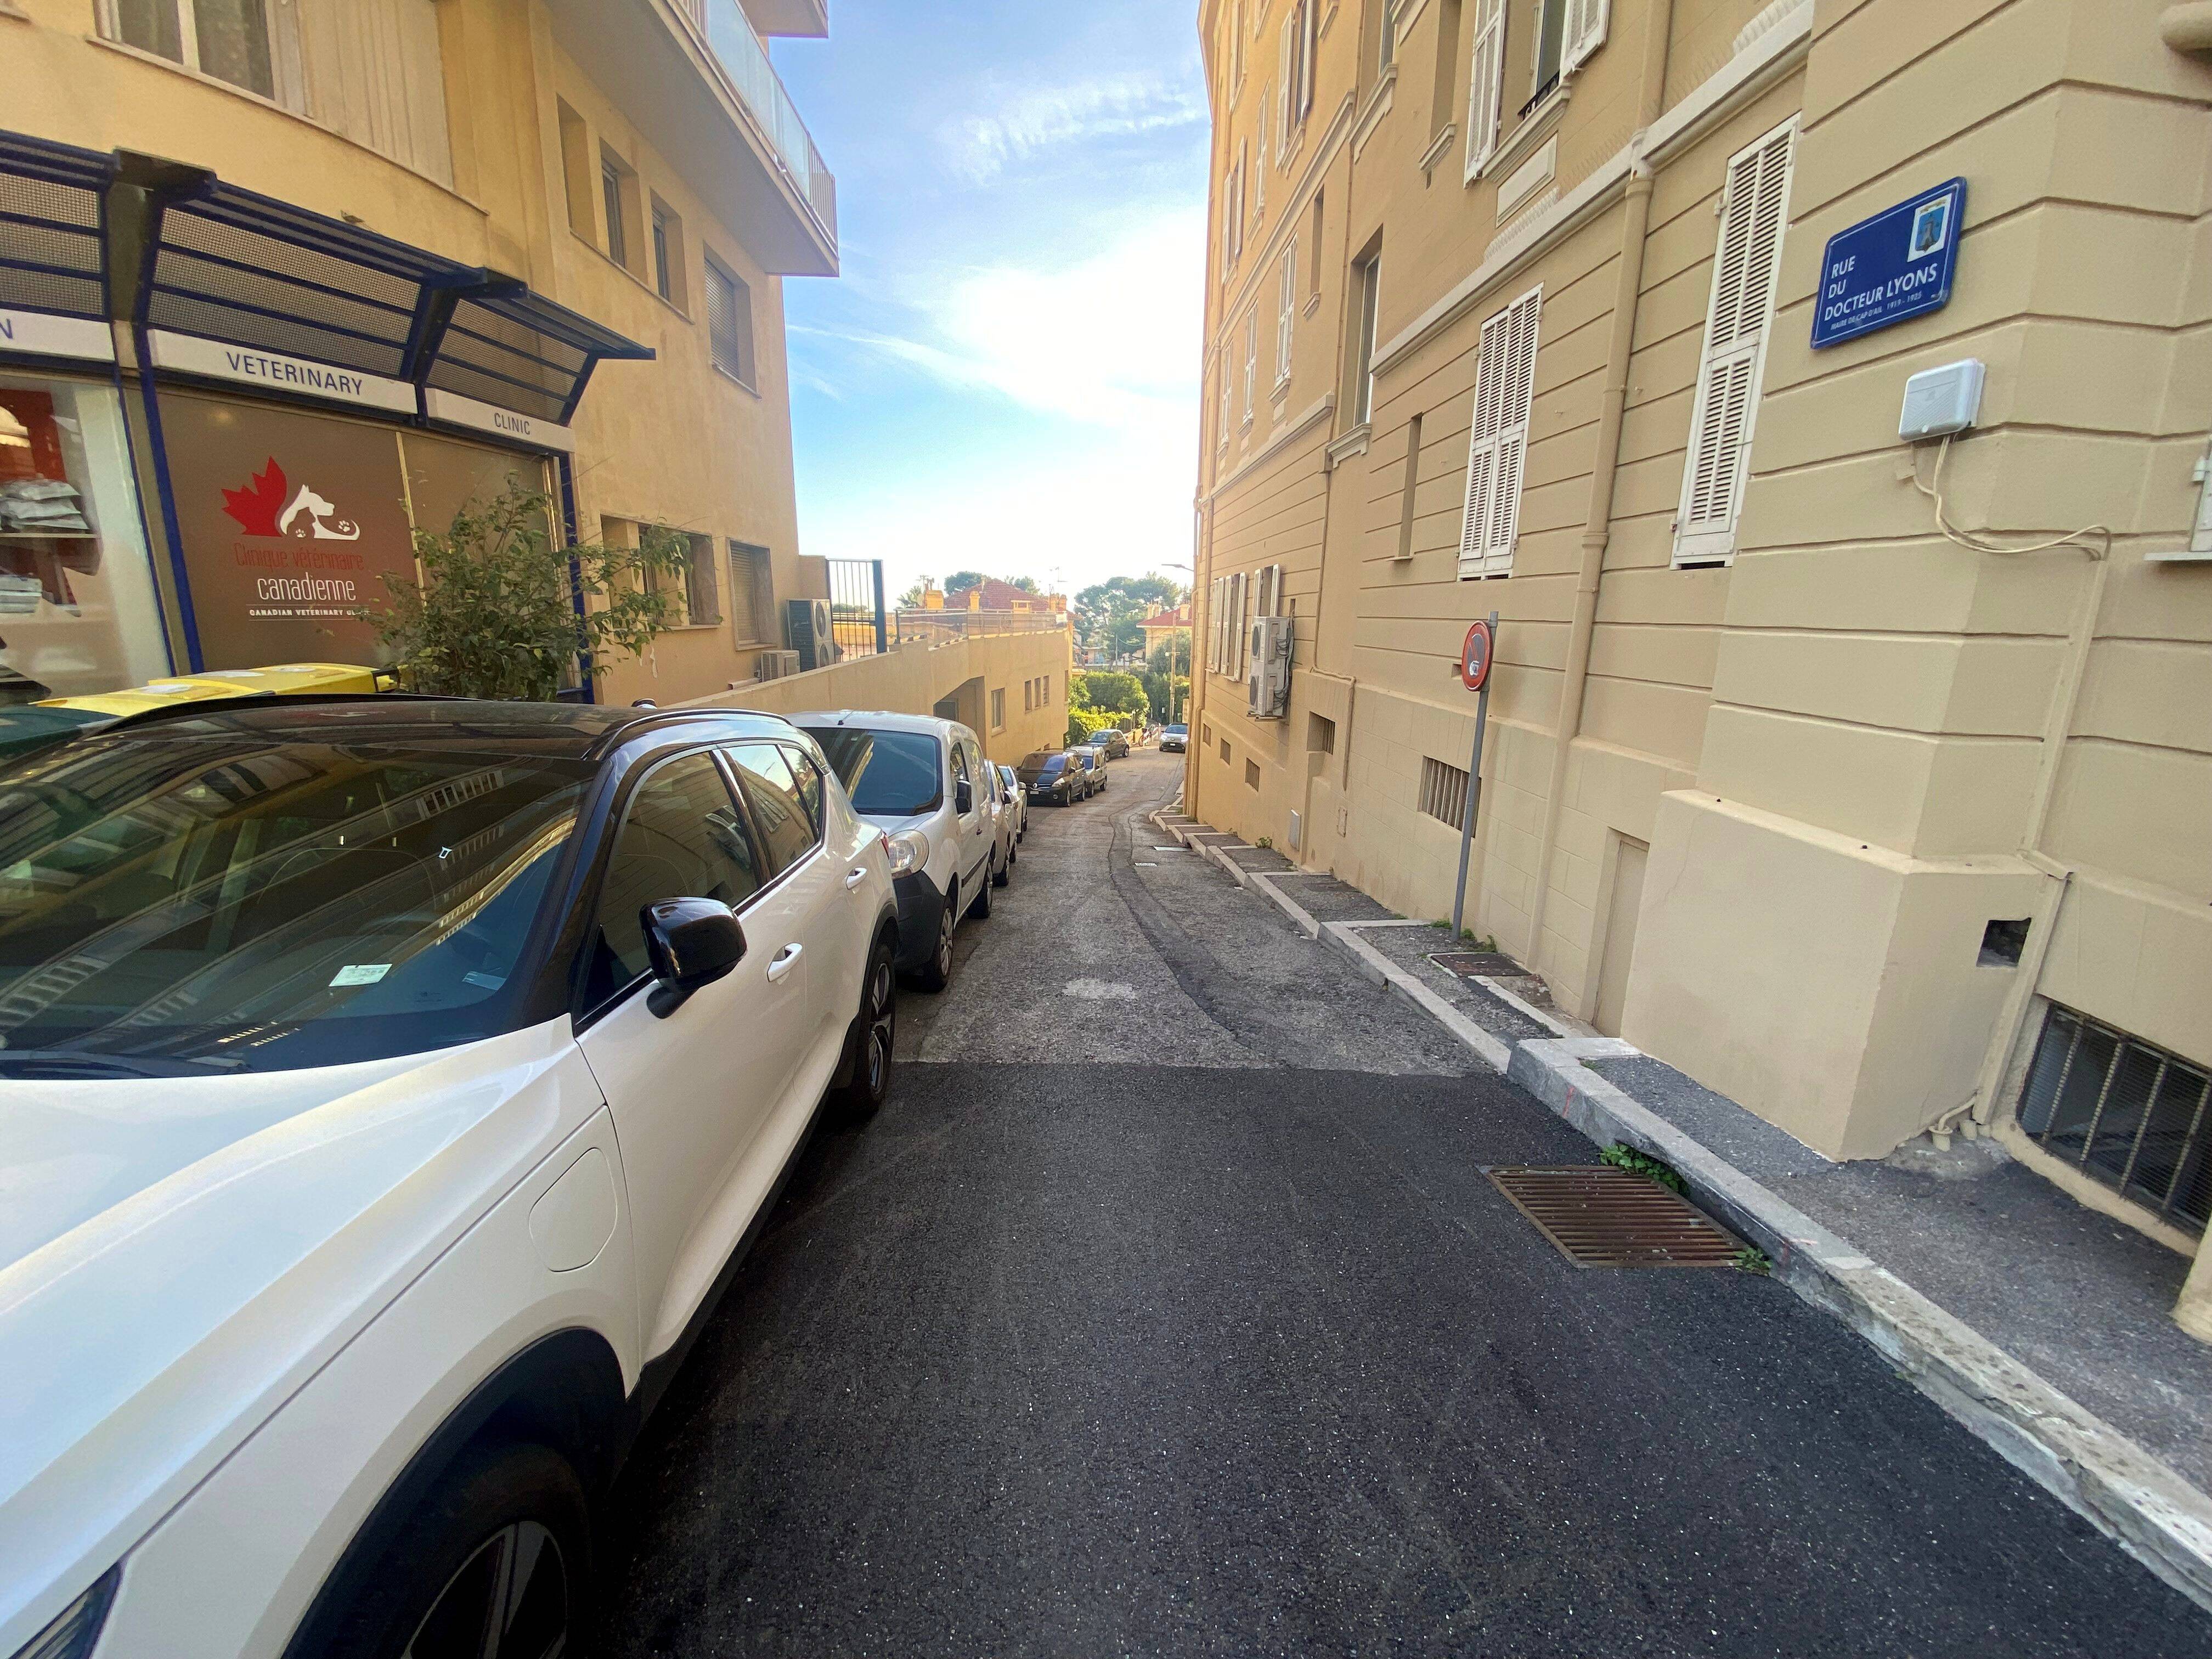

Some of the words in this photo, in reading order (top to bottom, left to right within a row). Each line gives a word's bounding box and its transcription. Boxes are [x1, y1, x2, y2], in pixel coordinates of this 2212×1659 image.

[1831, 255, 1856, 279] RUE
[1824, 286, 1884, 321] DOCTEUR
[1886, 263, 1938, 298] LYONS
[1828, 279, 1847, 299] DU
[1855, 312, 1867, 323] CAP
[226, 351, 363, 396] VETERINARY
[494, 412, 531, 435] CLINIC
[234, 542, 289, 572] Clinique
[292, 546, 365, 571] vétérinaire
[257, 571, 357, 601] canadienne
